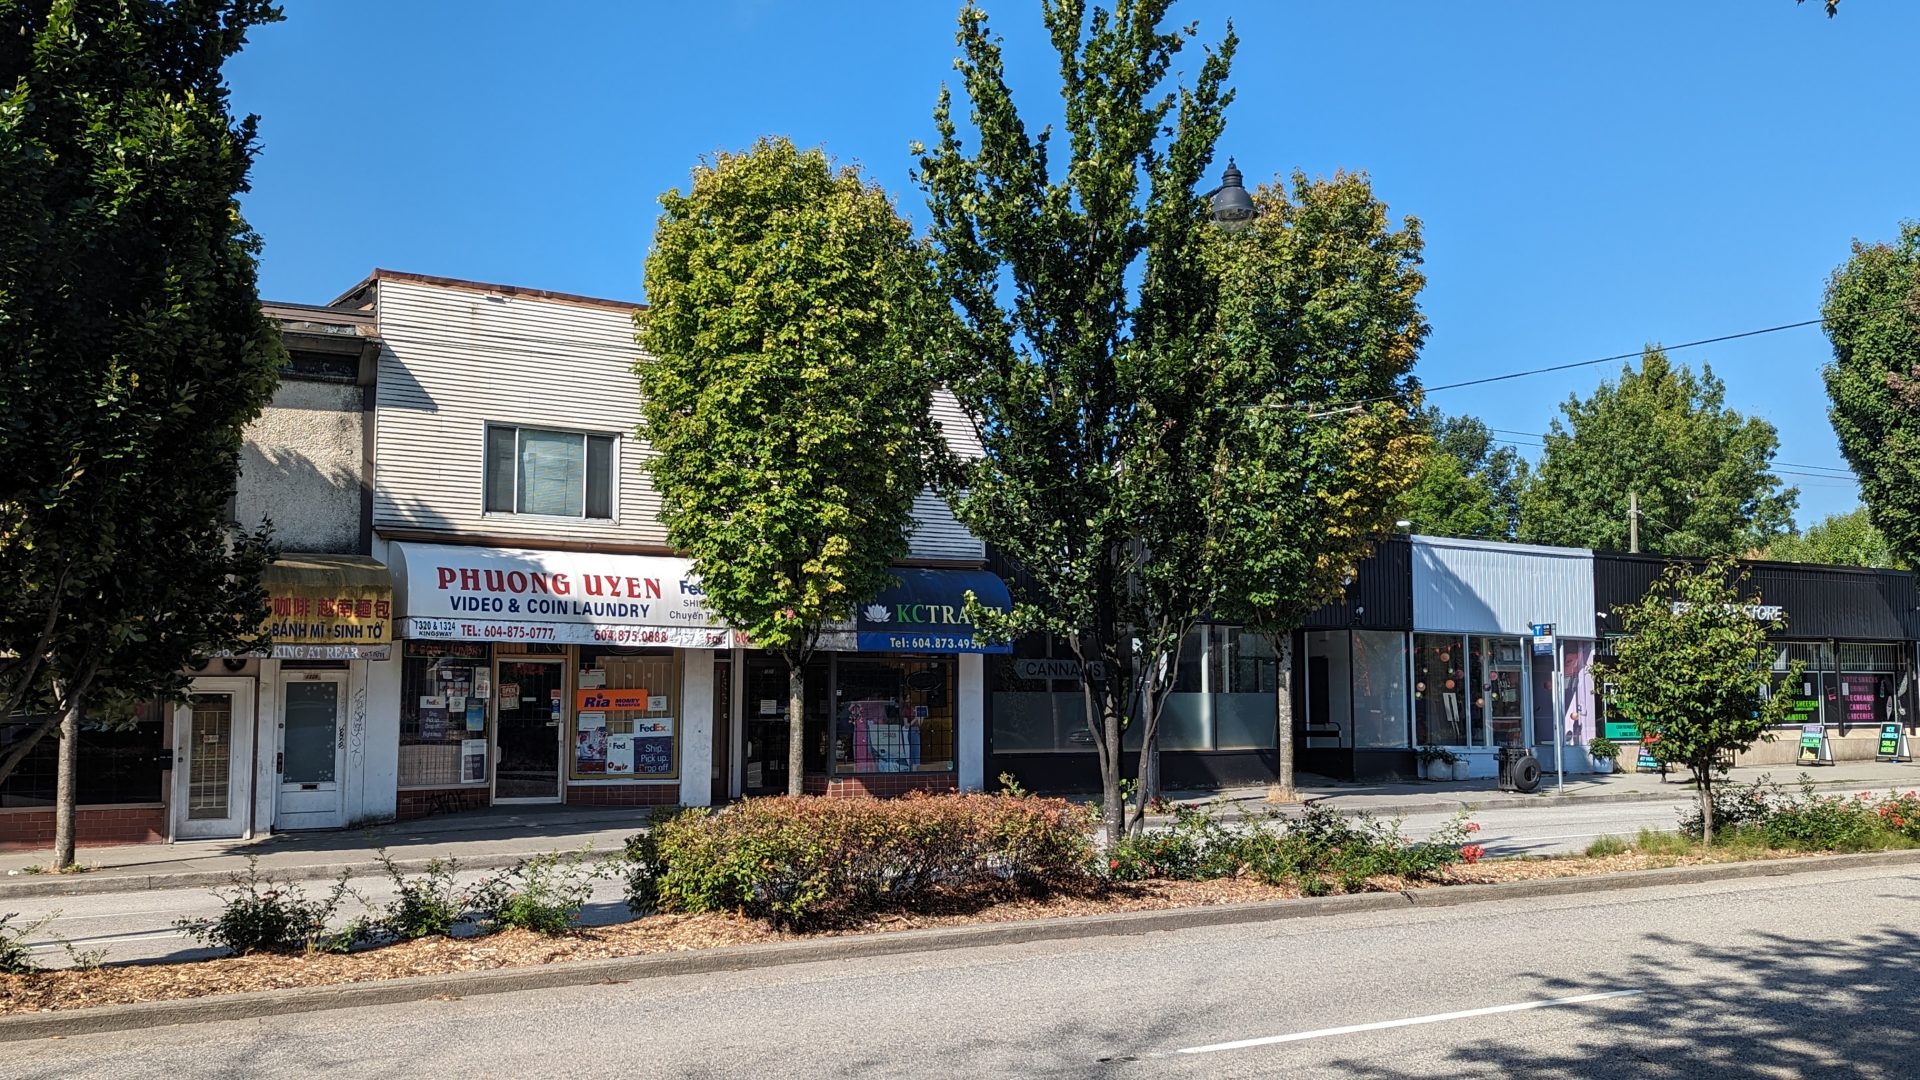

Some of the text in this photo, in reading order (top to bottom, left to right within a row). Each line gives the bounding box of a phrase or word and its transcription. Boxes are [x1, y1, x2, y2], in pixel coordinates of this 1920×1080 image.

[437, 566, 662, 600] PHUONG UYEN
[450, 596, 650, 619] VIDEO & COIN LAUNDRY
[272, 618, 307, 637] BÁNH
[334, 624, 363, 638] SINH
[415, 620, 456, 631] 1320 & 1324
[461, 624, 481, 637] TEL:
[890, 637, 910, 648] Tel:
[306, 646, 321, 659] AT
[326, 646, 360, 660] REAR
[1026, 662, 1101, 677] CANNAIS
[584, 693, 610, 708] Ria
[639, 723, 667, 733] FedEx
[641, 754, 656, 763] Pick
